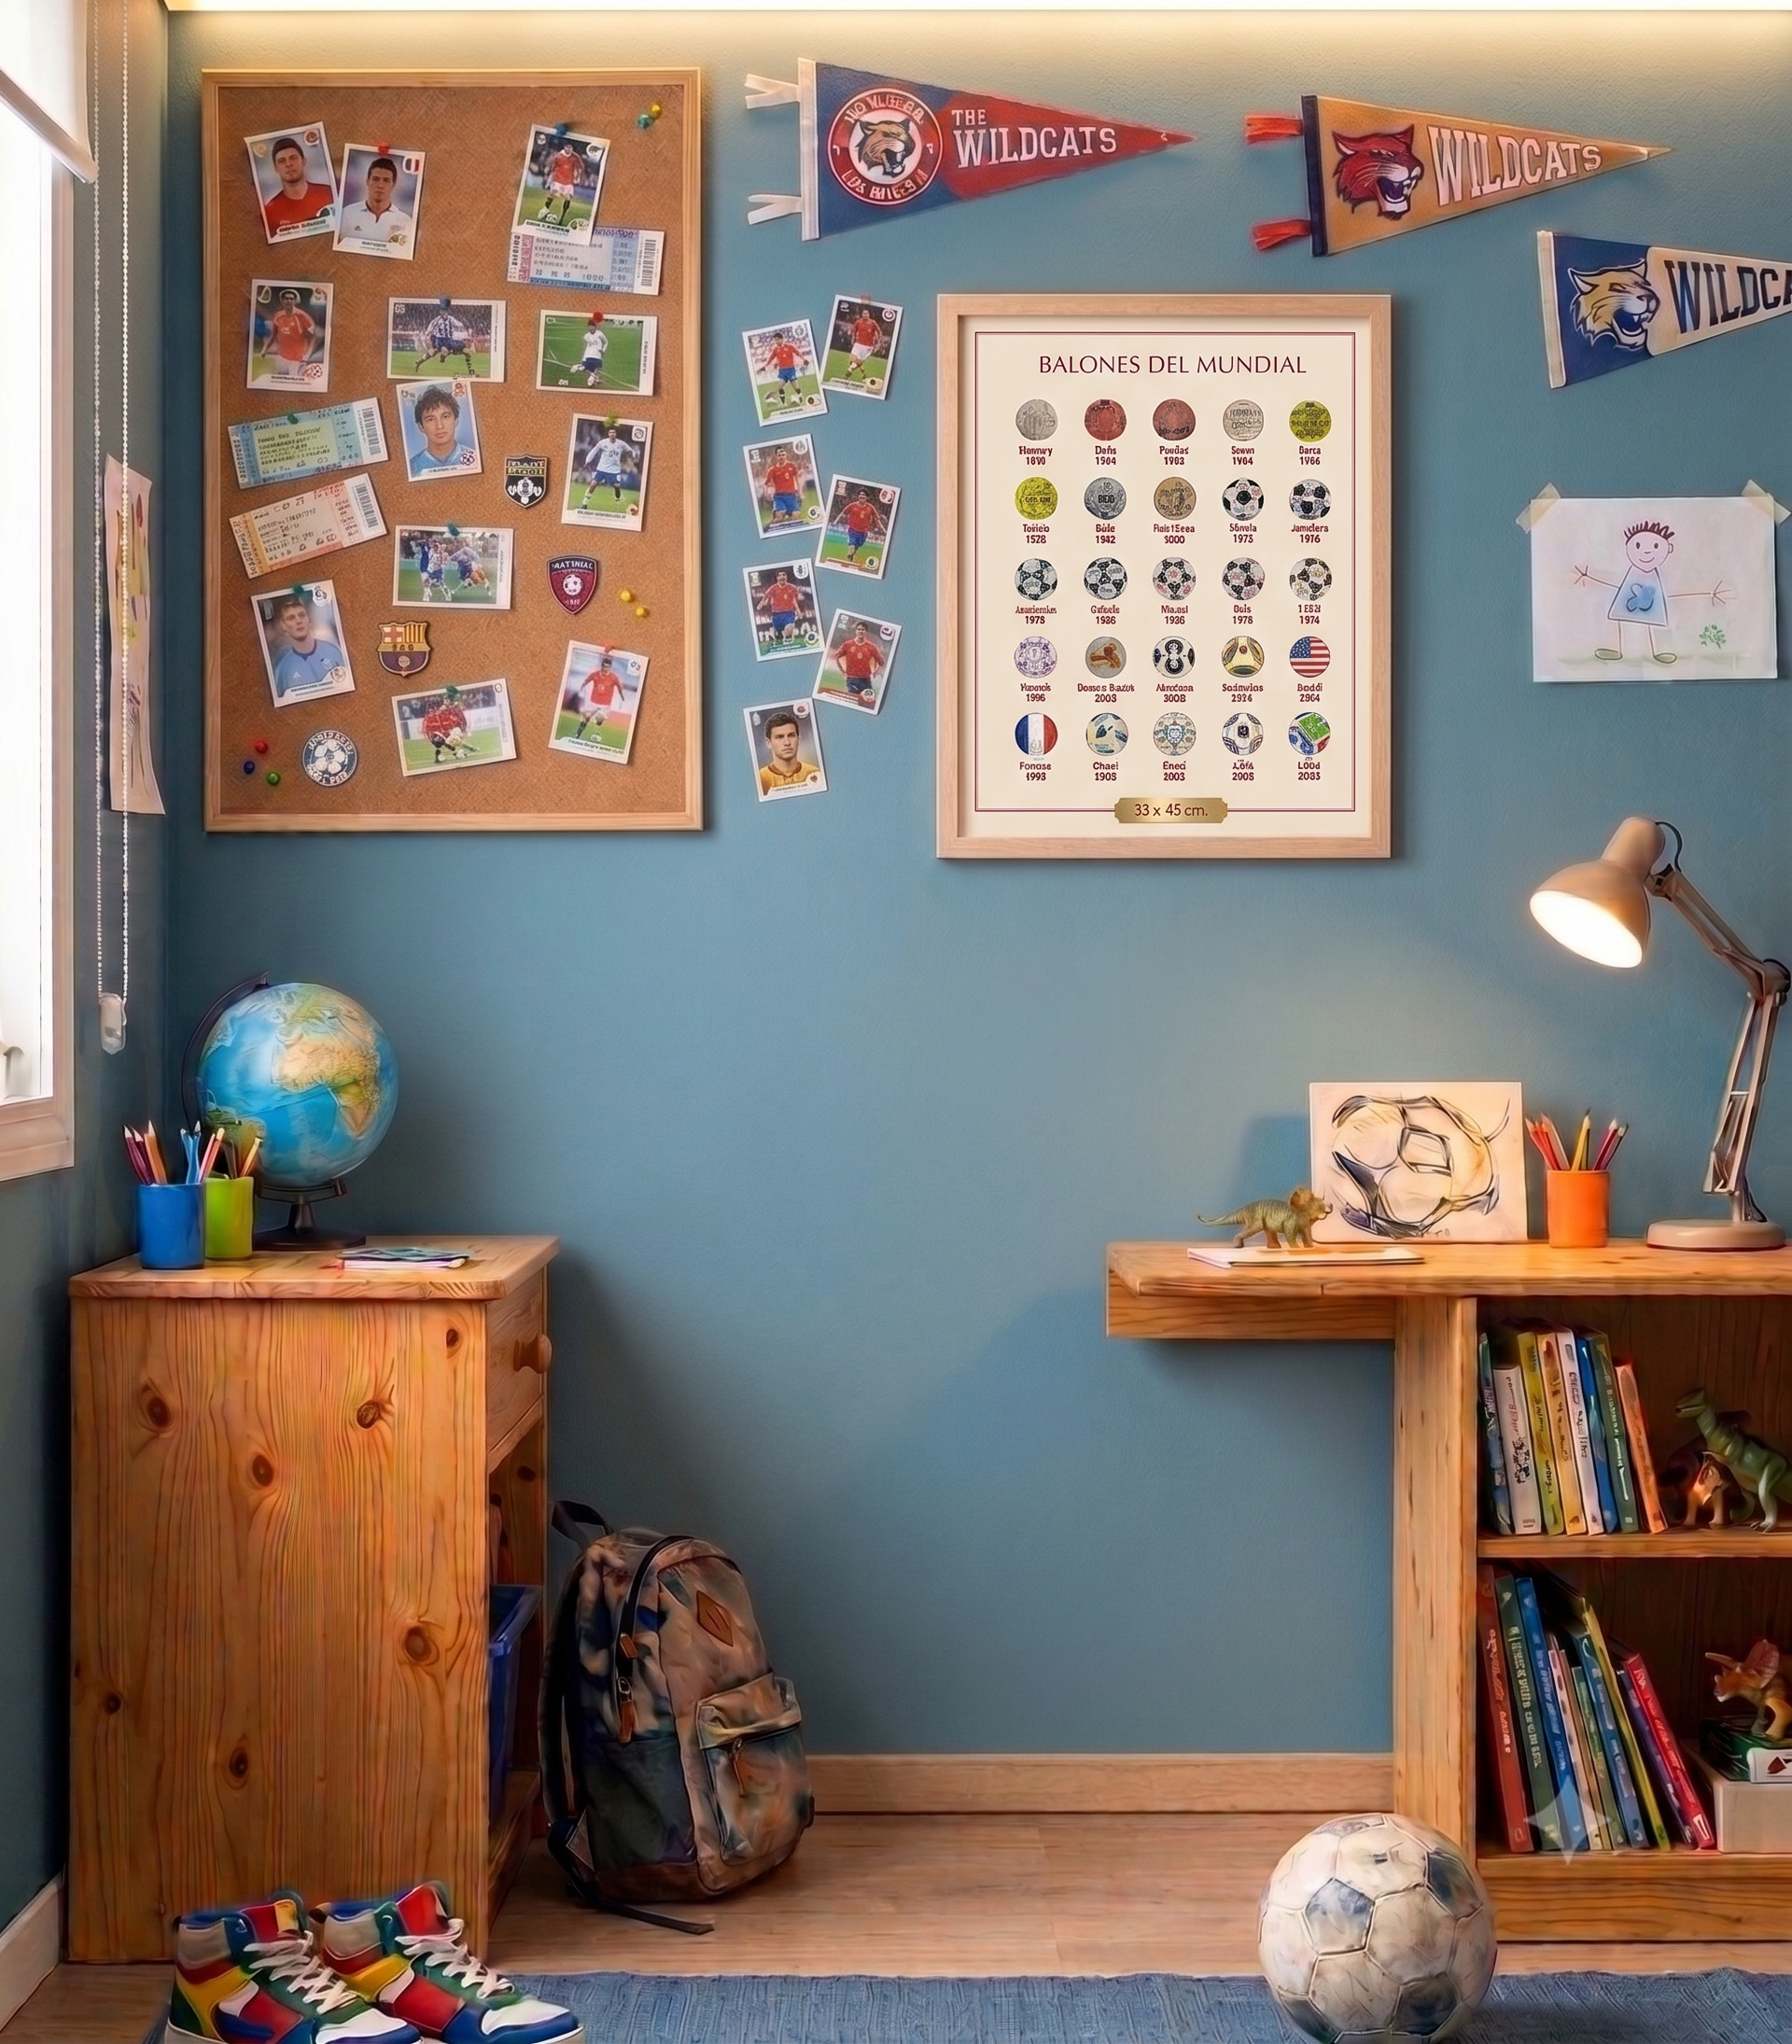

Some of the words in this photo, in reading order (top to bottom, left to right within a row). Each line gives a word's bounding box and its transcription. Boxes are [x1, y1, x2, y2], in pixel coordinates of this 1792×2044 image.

[951, 109, 987, 126] THE
[953, 127, 1117, 169] WILDCATS
[1427, 125, 1603, 206] WILDCATS
[1040, 355, 1141, 374] BALONES
[1149, 355, 1190, 373] DEL
[1197, 356, 1307, 374] MUNDIAL
[1134, 804, 1150, 817] 33
[1153, 807, 1161, 817] x
[1165, 804, 1182, 817] 45
[1183, 806, 1209, 817] cm.
